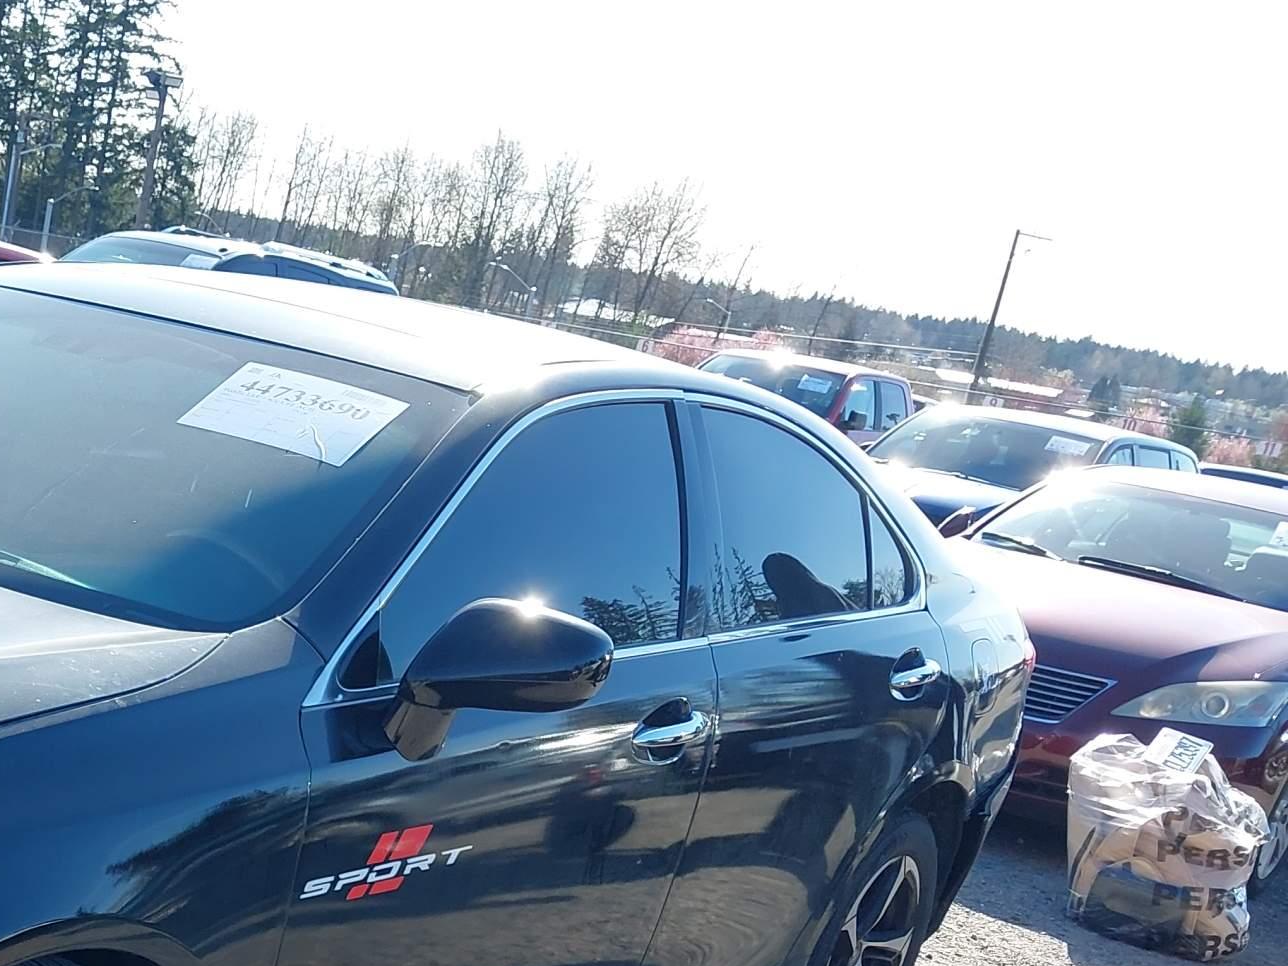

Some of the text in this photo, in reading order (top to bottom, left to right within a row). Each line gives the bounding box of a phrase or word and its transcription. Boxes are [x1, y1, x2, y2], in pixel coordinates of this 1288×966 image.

[642, 340, 649, 353] 6
[240, 380, 371, 420] 44733690
[299, 845, 473, 899] SPORT
